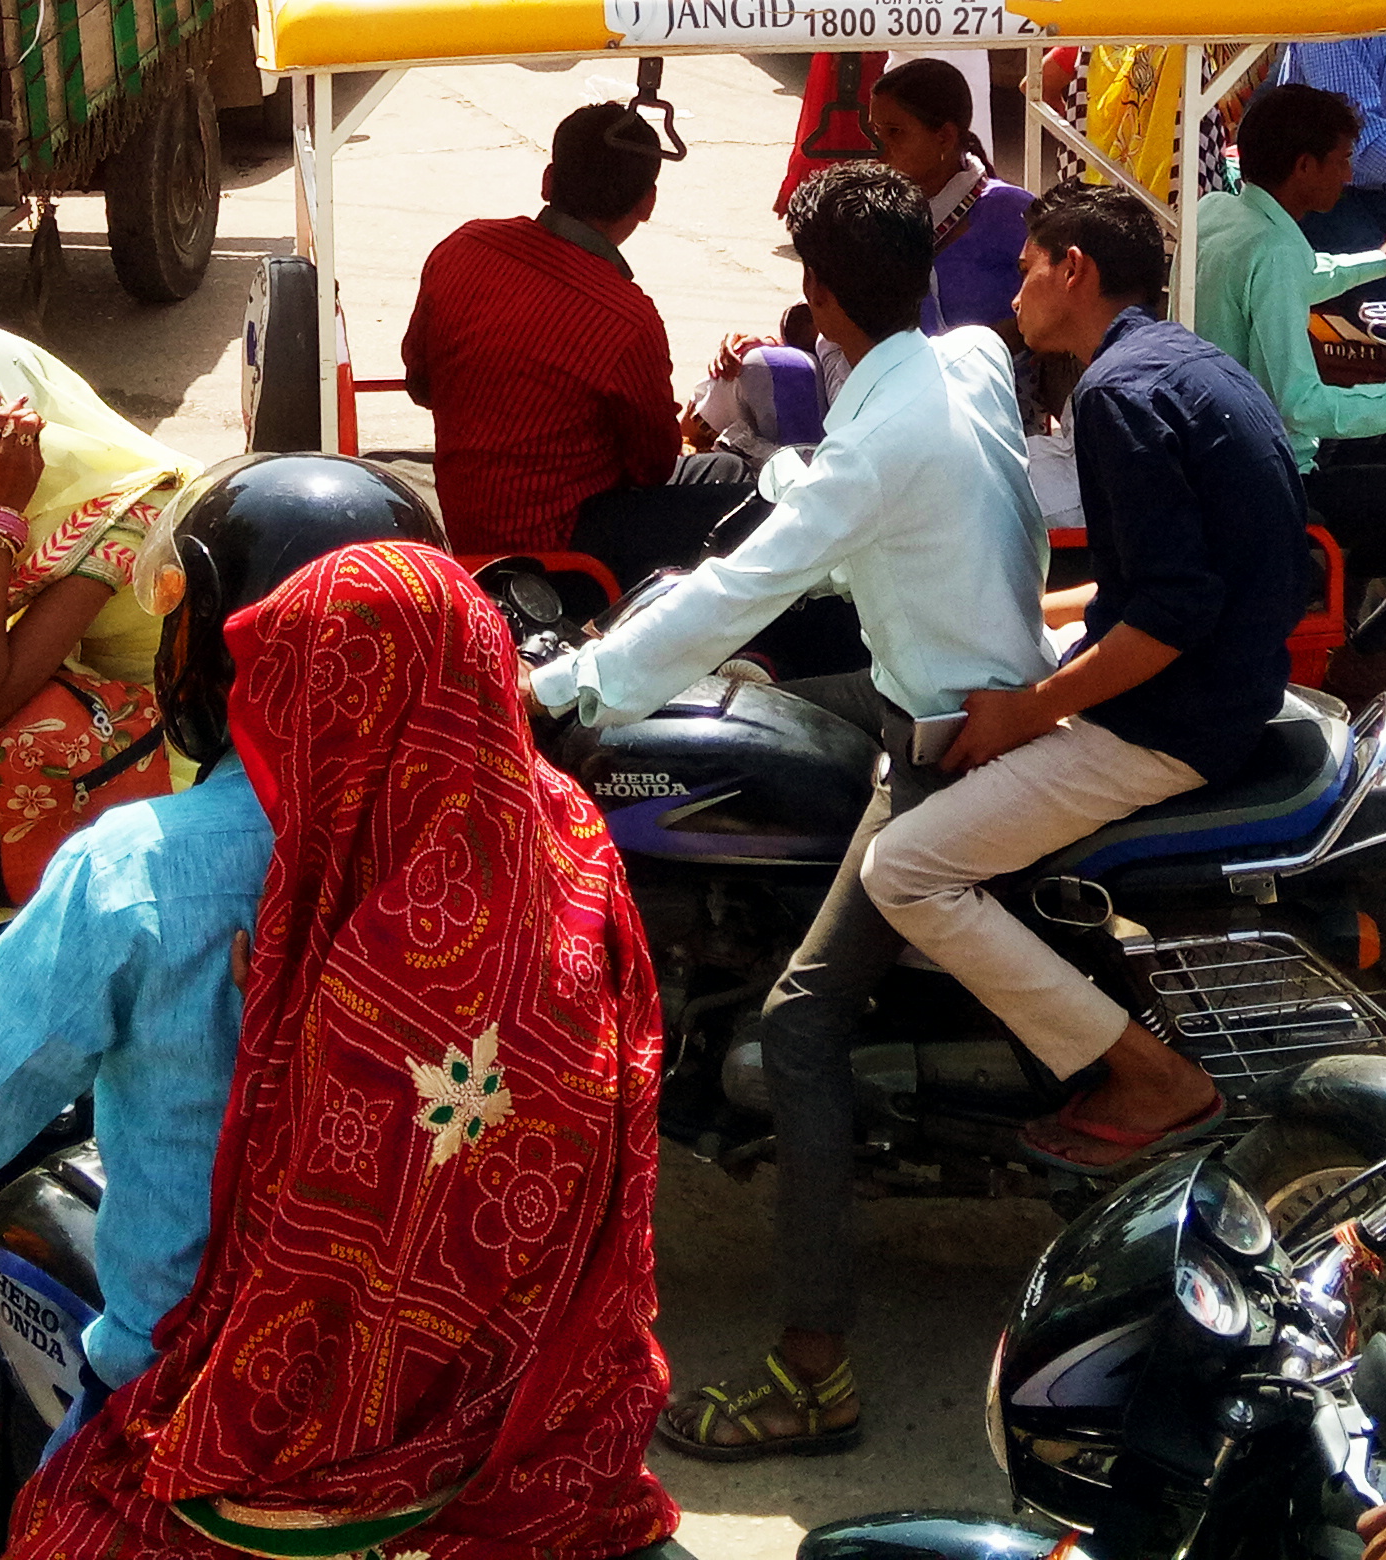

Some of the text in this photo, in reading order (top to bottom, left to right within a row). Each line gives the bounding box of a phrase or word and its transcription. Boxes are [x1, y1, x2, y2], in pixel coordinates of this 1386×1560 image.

[804, 8, 875, 38] 1800
[887, 8, 941, 37] 300
[953, 6, 1004, 36] 271
[611, 773, 670, 784] HERO
[594, 782, 691, 797] HONDA
